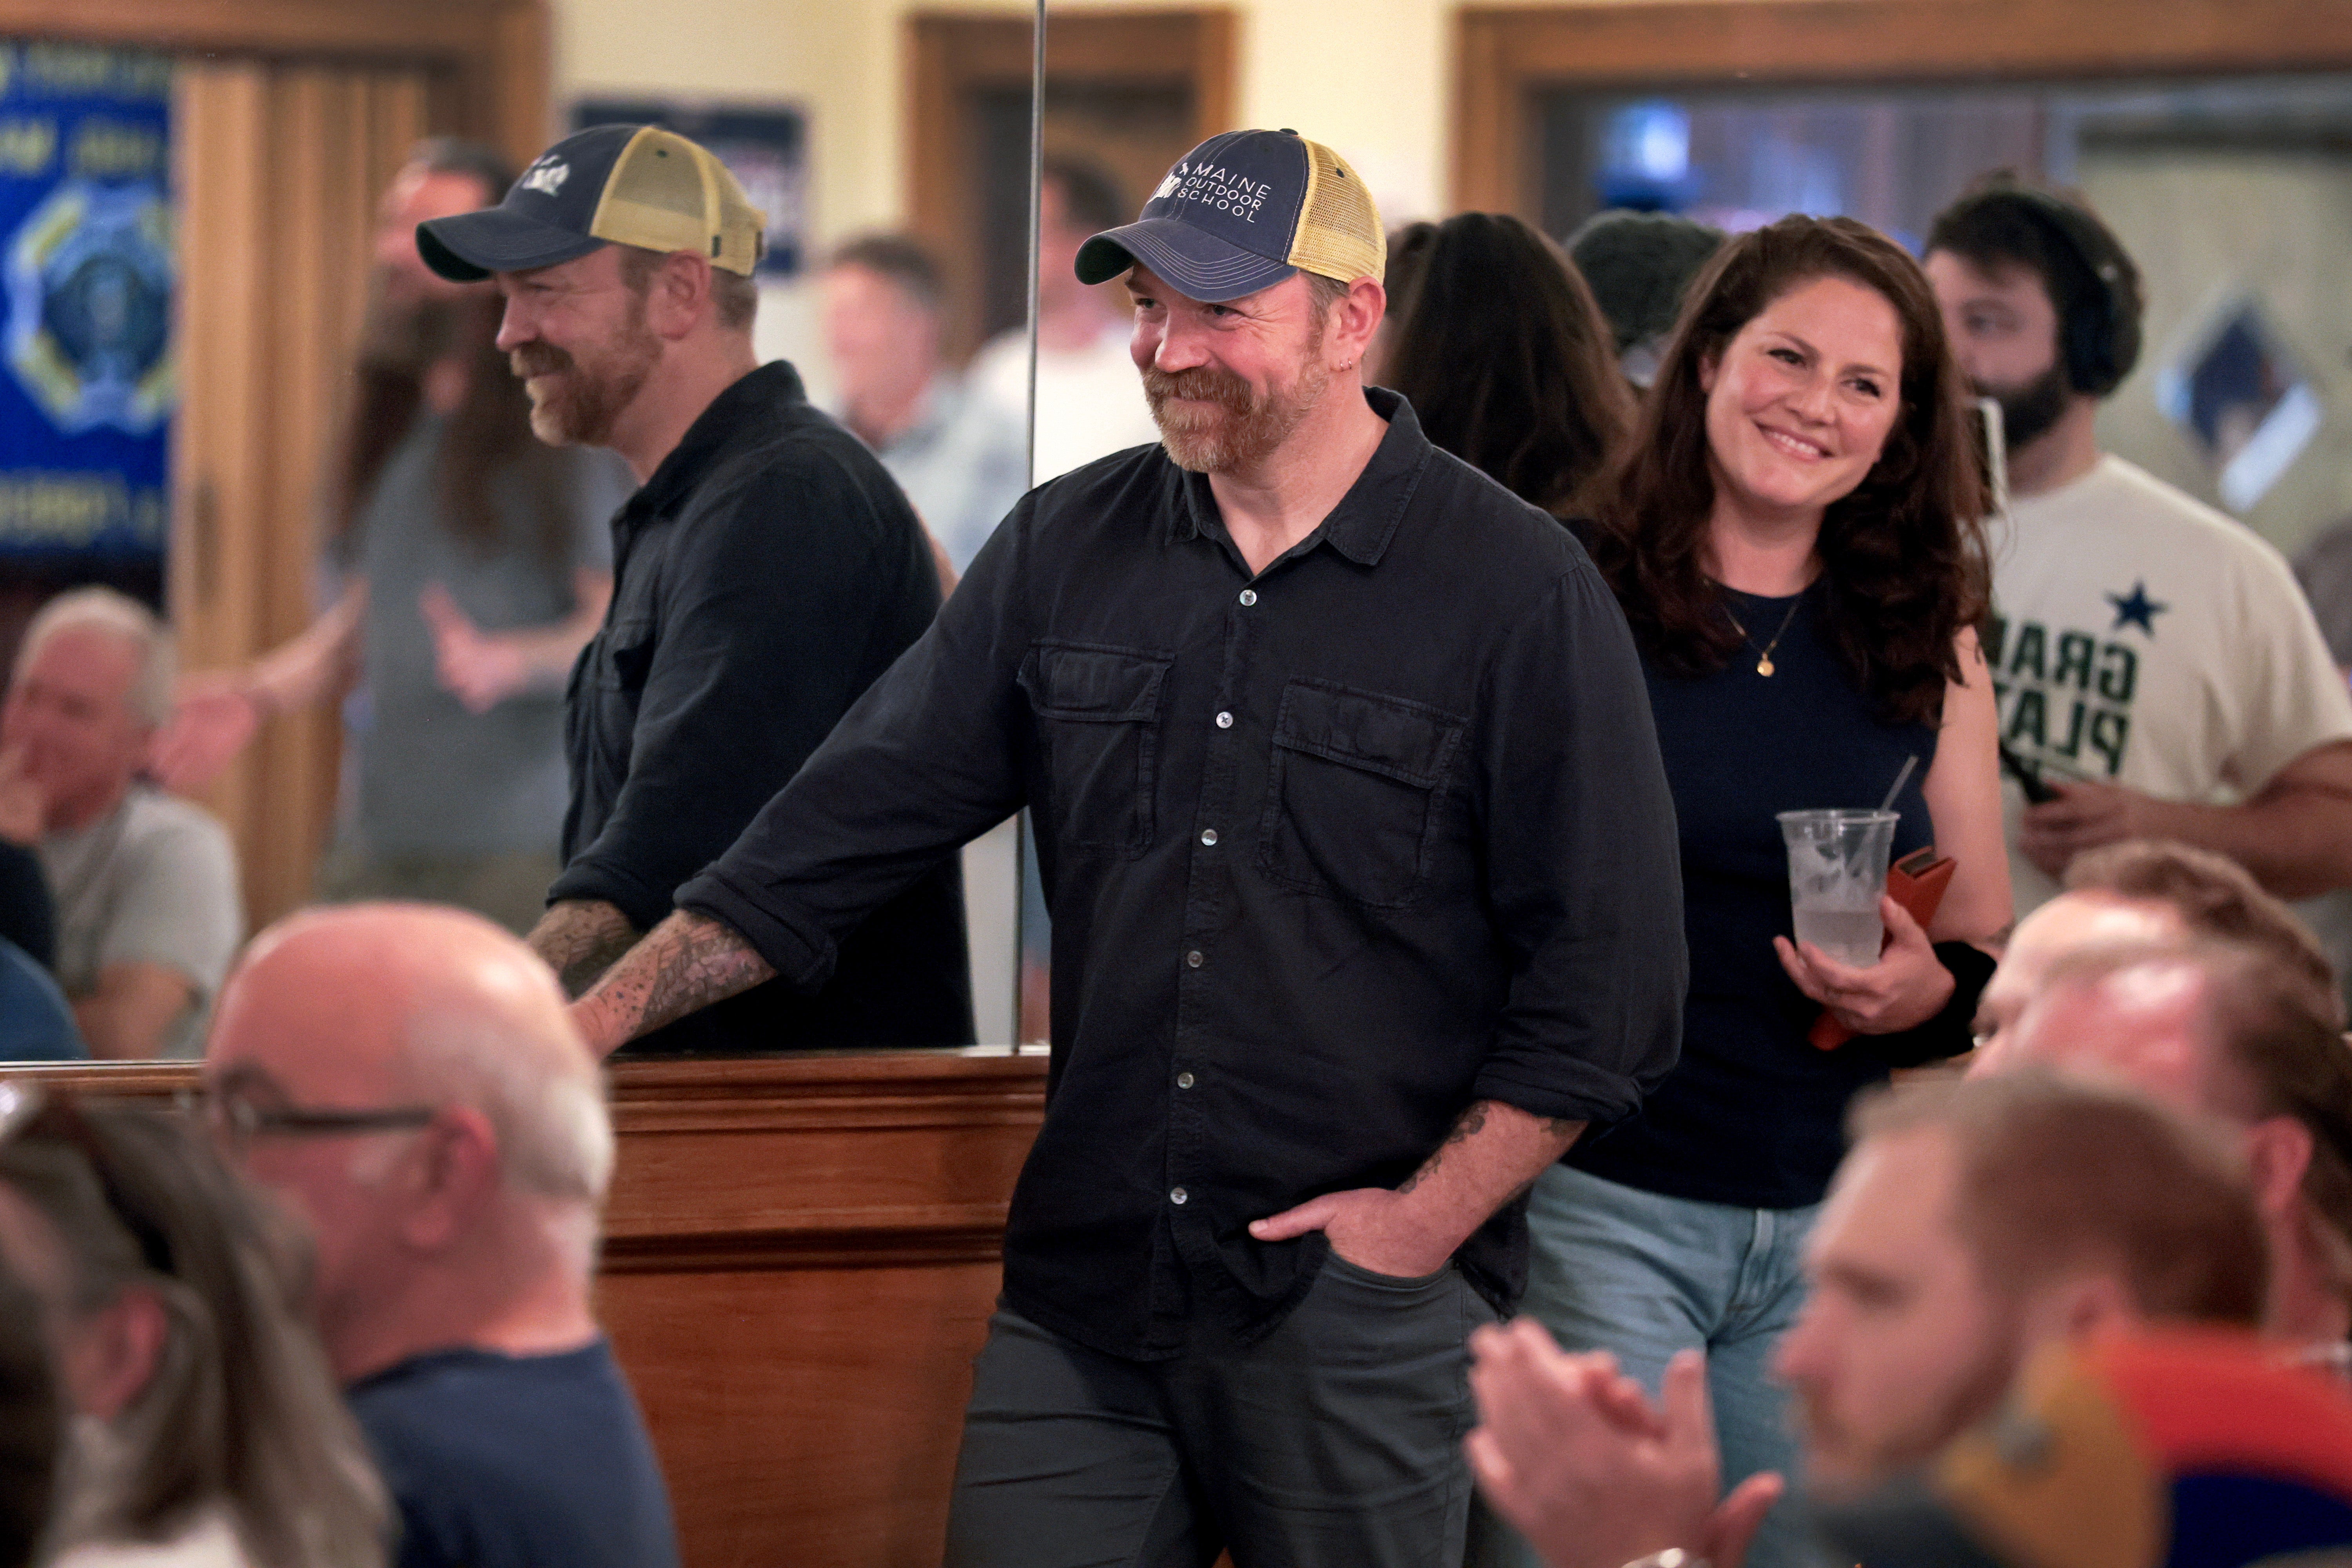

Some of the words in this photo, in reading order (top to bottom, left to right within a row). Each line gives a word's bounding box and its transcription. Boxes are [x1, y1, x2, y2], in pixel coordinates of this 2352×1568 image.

[1185, 177, 1261, 210] OUTDOOR
[1192, 162, 1271, 199] MAINE
[1178, 188, 1254, 223] SCHOOL
